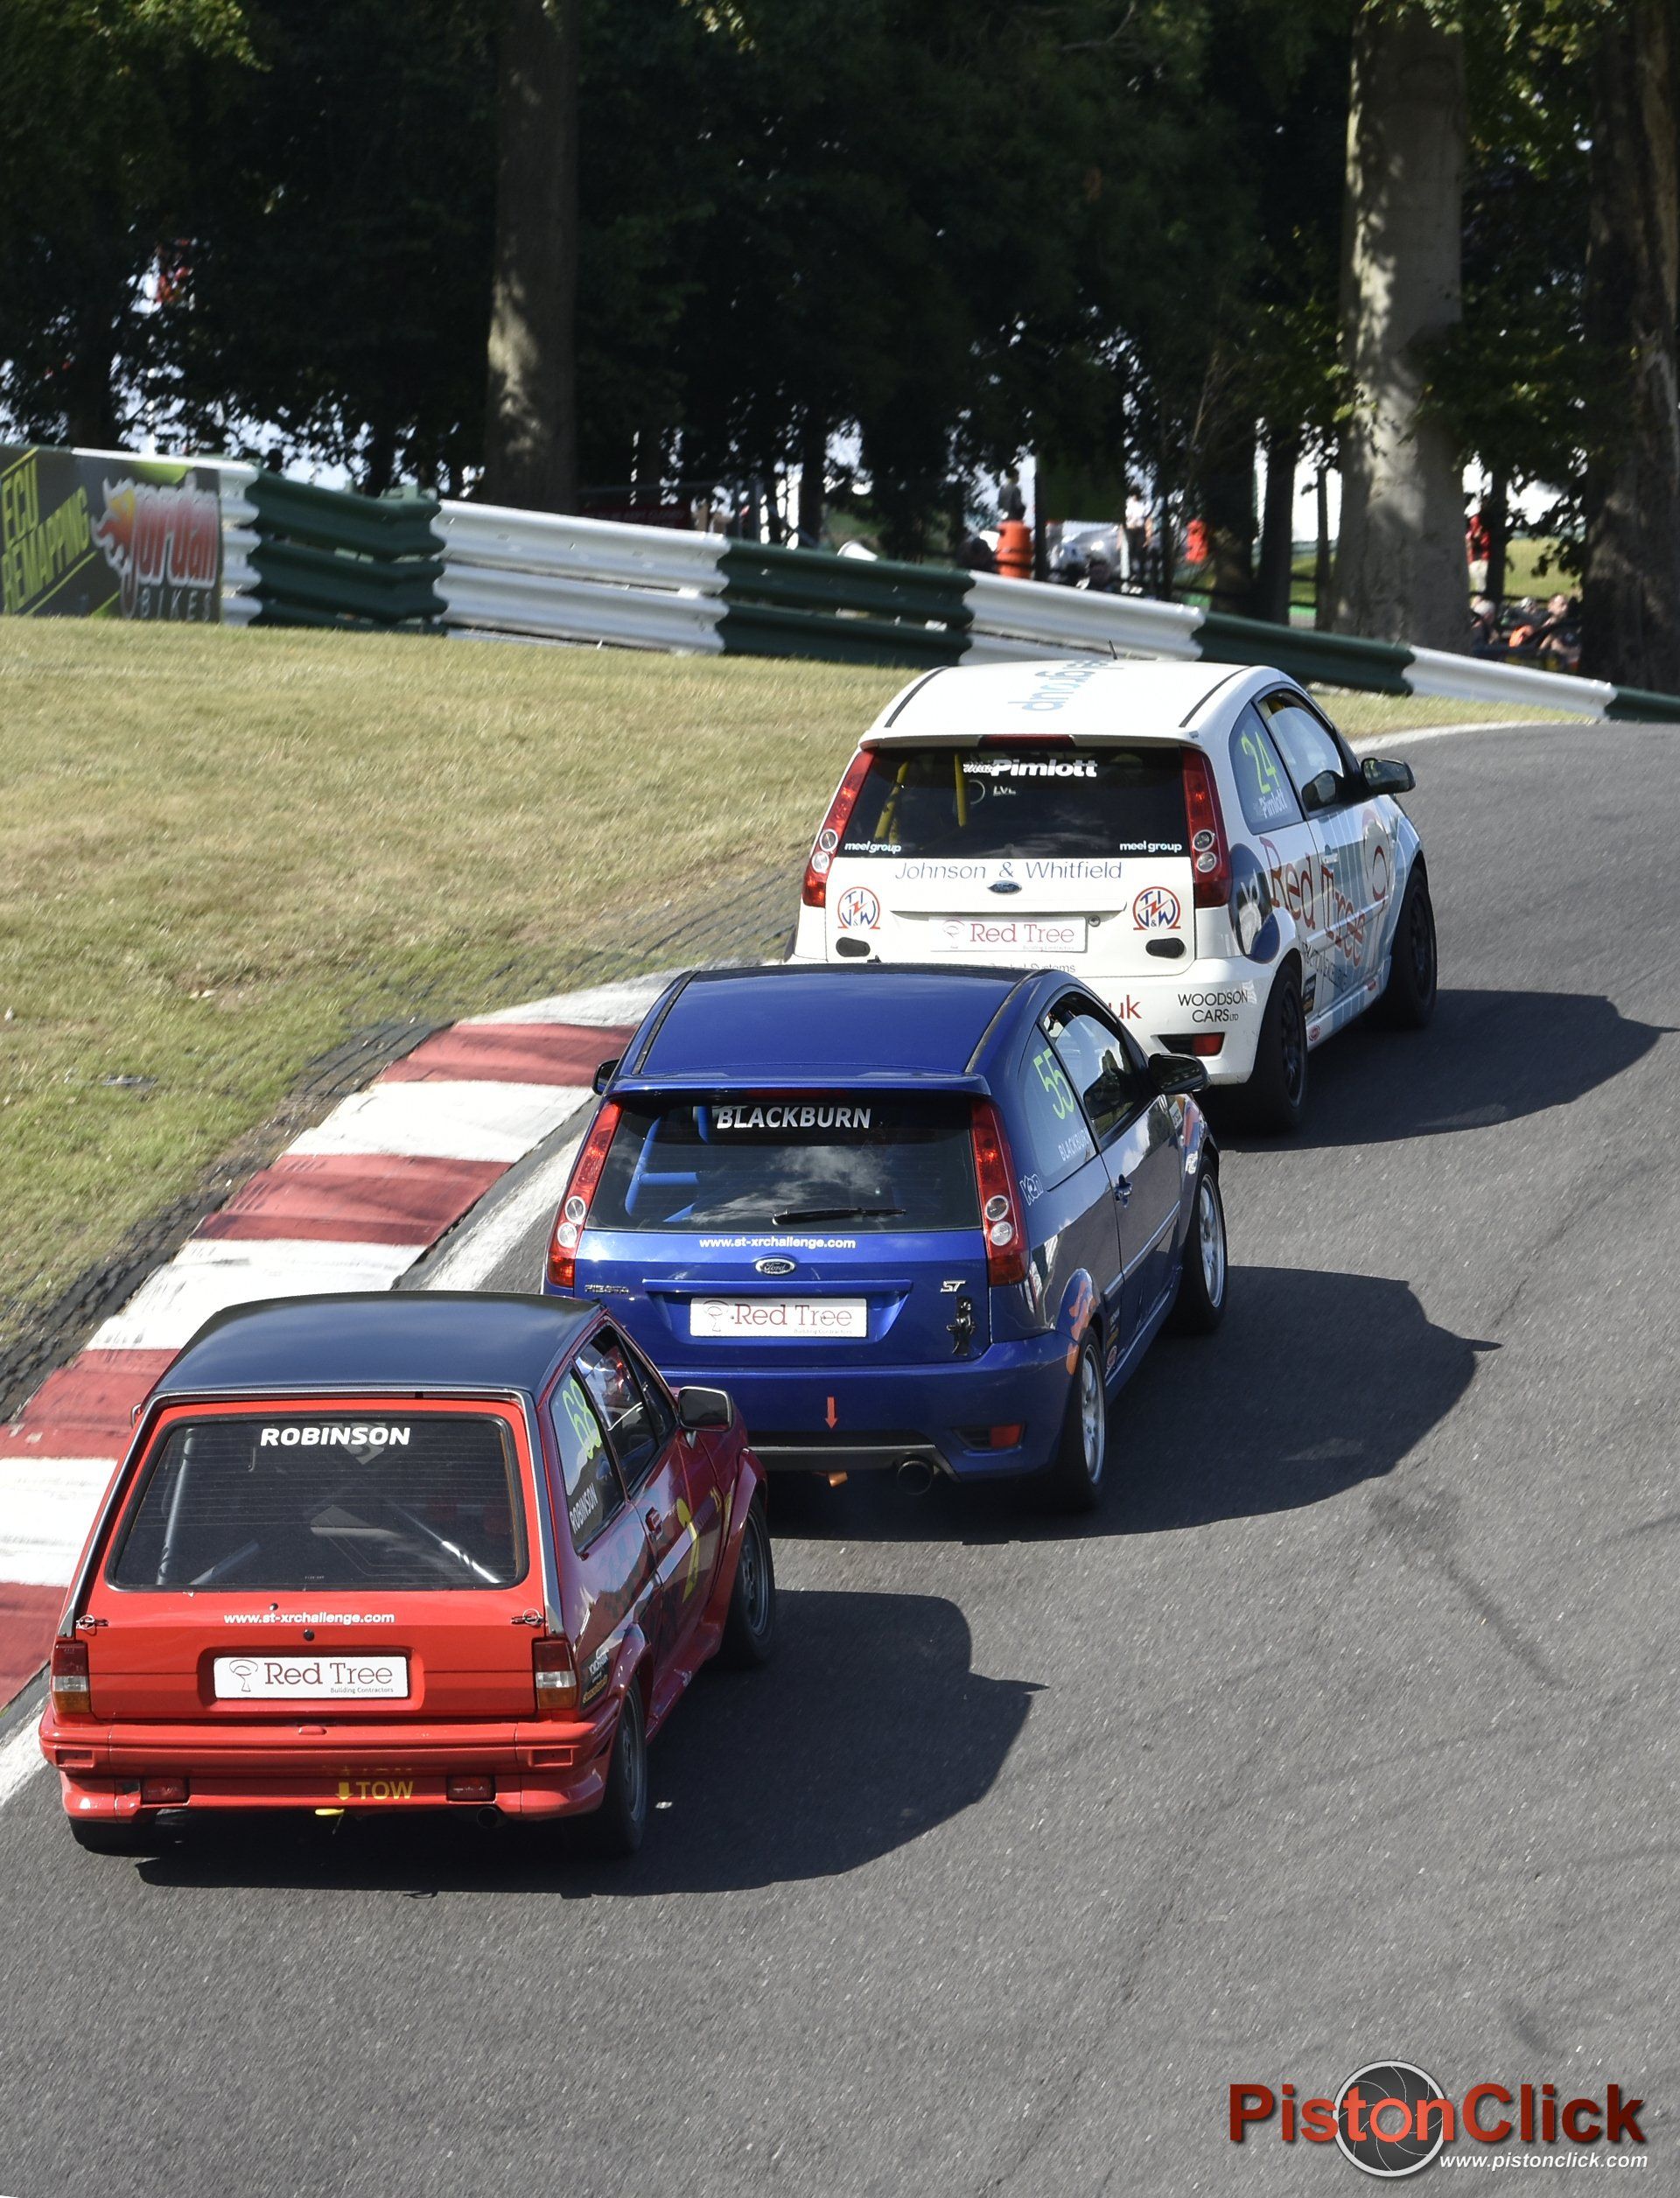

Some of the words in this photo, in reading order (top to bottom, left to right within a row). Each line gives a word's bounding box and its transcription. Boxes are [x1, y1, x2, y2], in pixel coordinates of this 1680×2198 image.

[2, 457, 39, 549] ECU
[140, 590, 213, 621] BIKES
[990, 759, 1098, 778] Pimlott
[1241, 731, 1280, 794] 24
[895, 862, 986, 879] Johnson
[998, 861, 1014, 879] &
[1026, 861, 1123, 879] Whitfield
[1259, 836, 1316, 930] Red
[1320, 864, 1366, 967] Tree
[970, 923, 1018, 943] Red
[1024, 924, 1074, 943] Tree
[1178, 991, 1249, 1007] WOODSON
[1192, 1008, 1229, 1023] CARS
[1032, 1046, 1074, 1121] 55
[717, 1105, 872, 1130] BLACKBURN
[698, 1236, 857, 1250] www.st-xrchallenge.com
[939, 1279, 968, 1293] ST
[734, 1304, 788, 1326] Red
[794, 1305, 853, 1326] Tree
[562, 1378, 602, 1460] 68
[260, 1426, 410, 1447] ROBINSON
[569, 1481, 599, 1536] ROBINSON
[223, 1611, 396, 1626] www.st-xrchallenge.com
[264, 1662, 323, 1685] Red
[329, 1662, 394, 1684] Tree
[330, 1686, 356, 1695] Building
[355, 1781, 414, 1800] TOW
